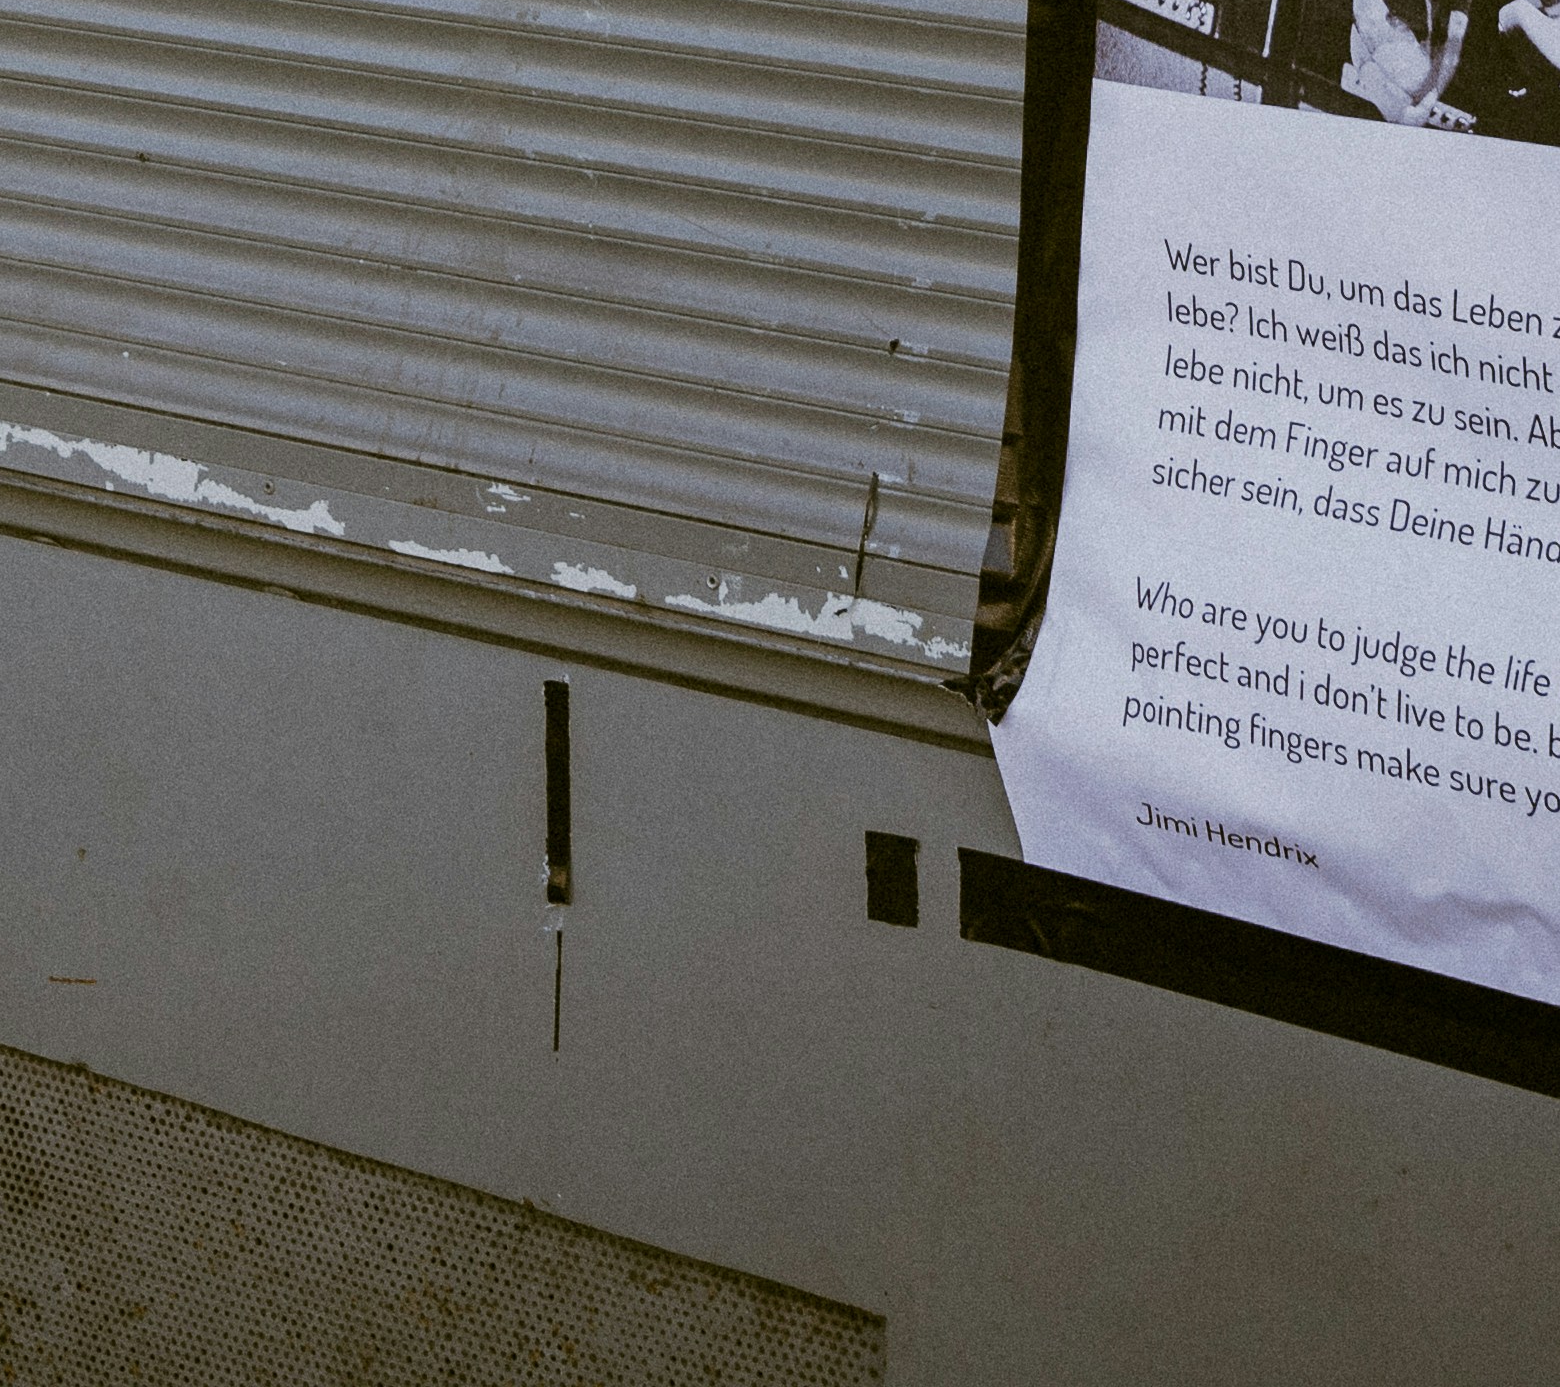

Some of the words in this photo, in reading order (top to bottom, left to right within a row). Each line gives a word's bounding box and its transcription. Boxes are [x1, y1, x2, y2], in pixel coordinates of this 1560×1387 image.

[1163, 238, 1221, 277] Wer
[1228, 248, 1280, 289] bist
[1287, 258, 1332, 301] Du,
[1339, 279, 1386, 308] um
[1392, 279, 1443, 319] das
[1451, 288, 1544, 337] Leben
[1121, 696, 1242, 751] pointing
[1249, 711, 1349, 767] fingers
[1356, 747, 1441, 788] make
[1449, 769, 1517, 805] sure
[1135, 801, 1199, 838] Jimi
[1205, 820, 1320, 869] Hendrix
